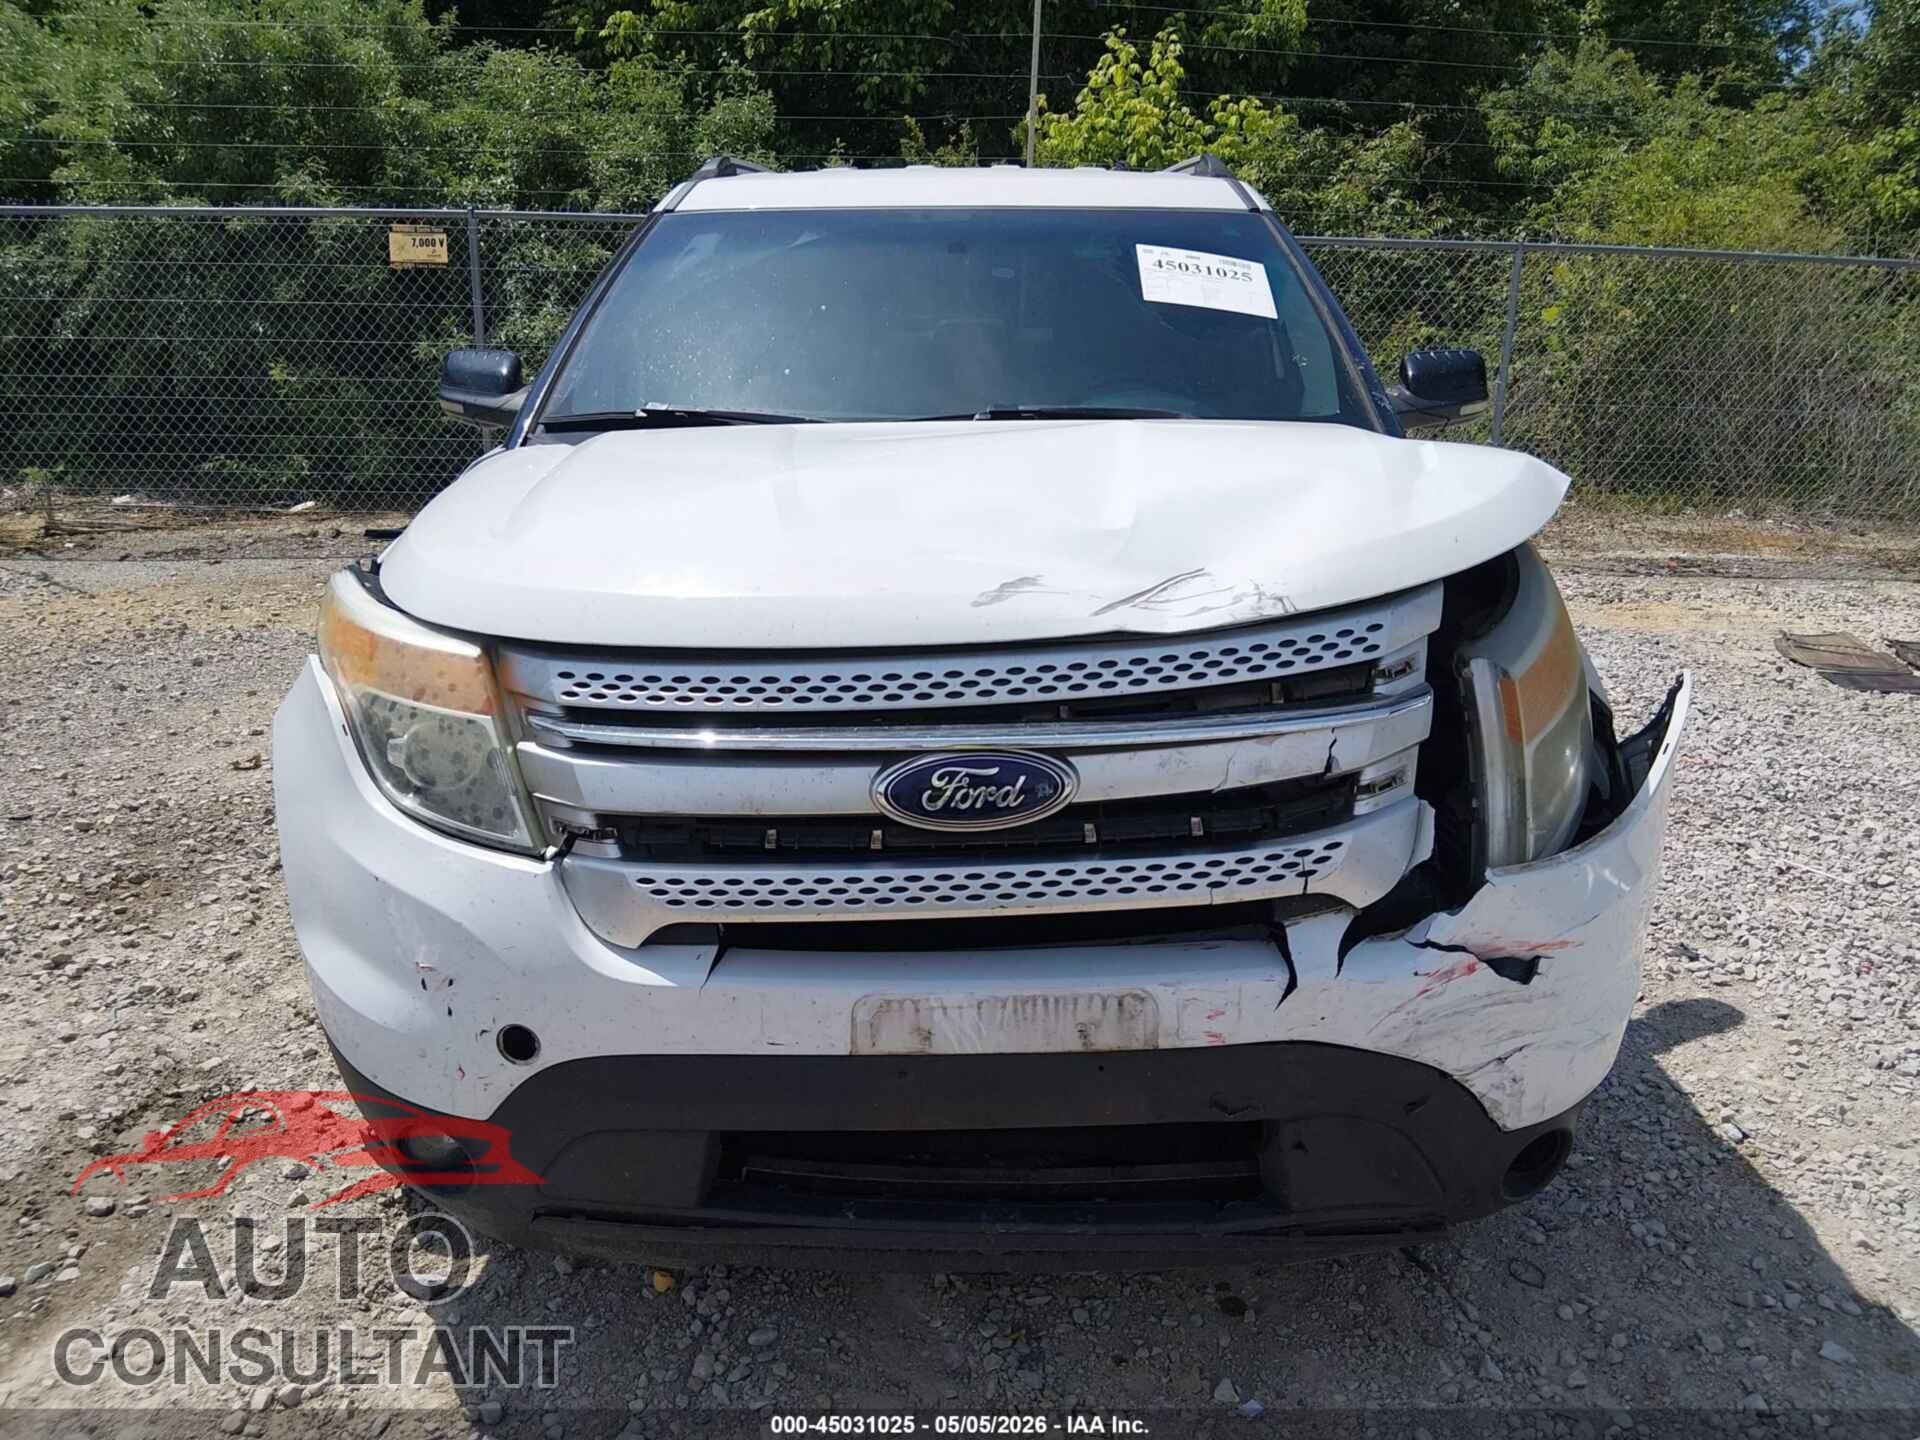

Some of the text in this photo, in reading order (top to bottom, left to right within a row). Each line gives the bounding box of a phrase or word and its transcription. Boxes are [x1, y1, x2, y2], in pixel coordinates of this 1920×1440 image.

[411, 237, 445, 248] 7,000 V
[1153, 258, 1253, 282] 45031025
[921, 766, 1026, 811] Ford
